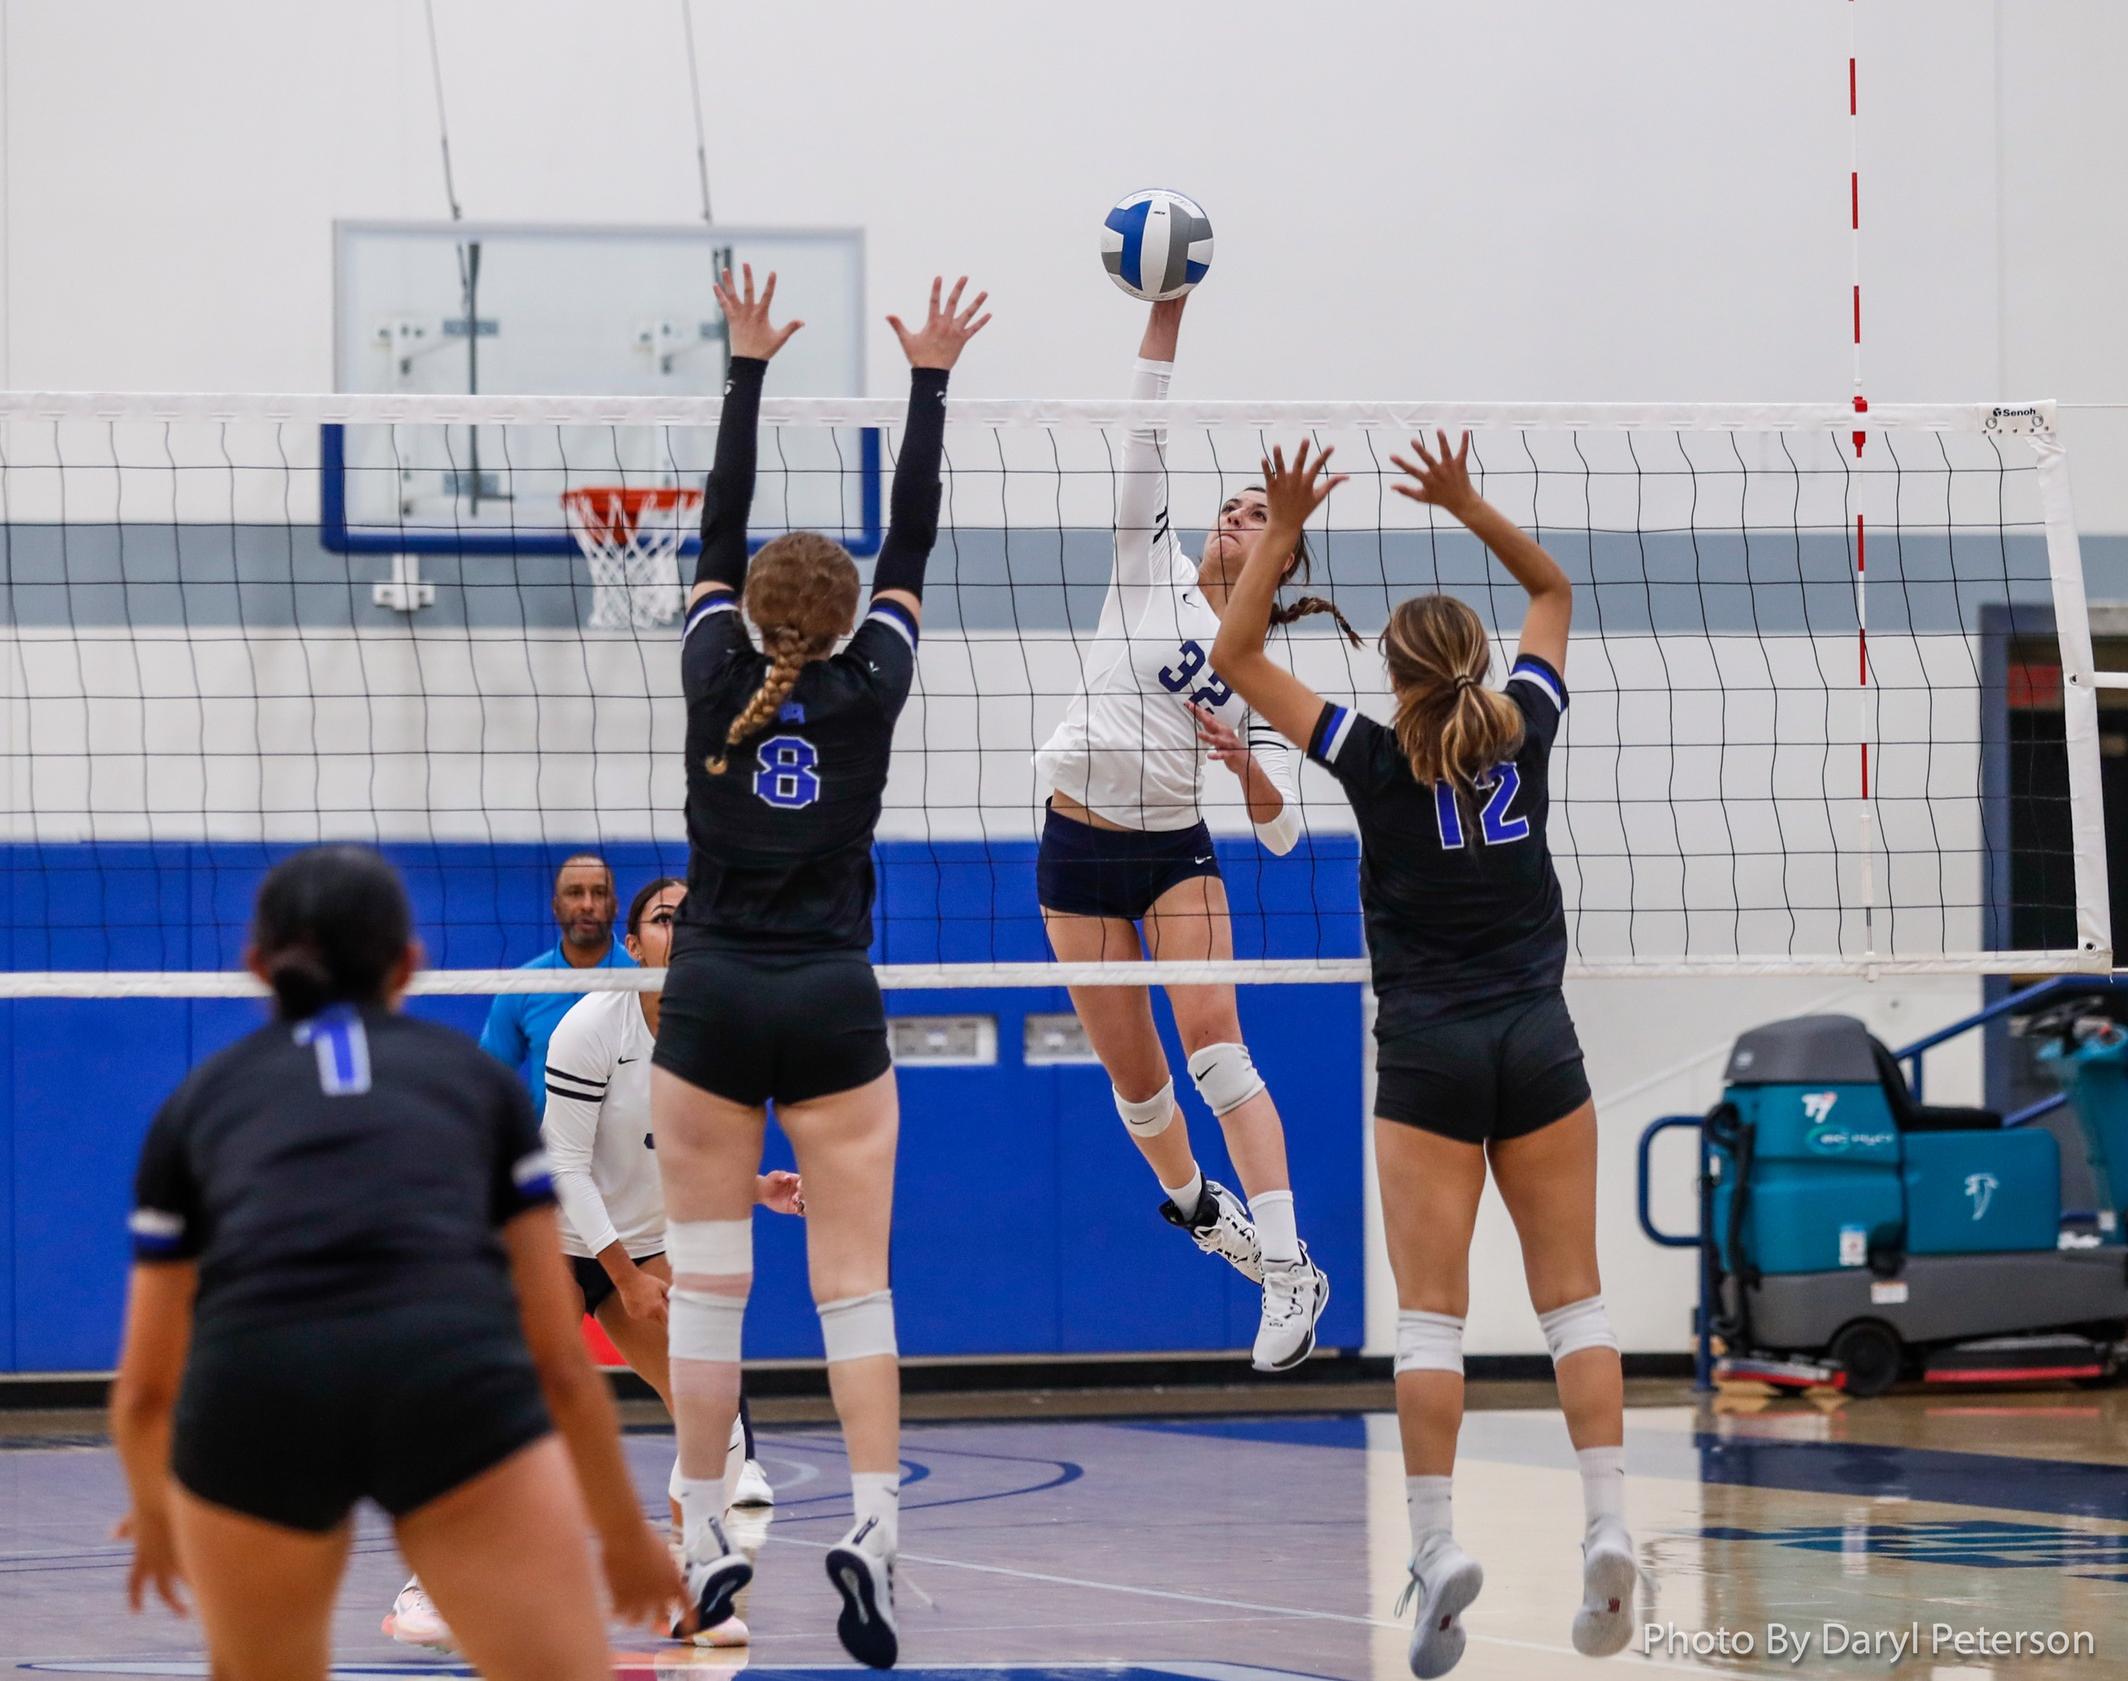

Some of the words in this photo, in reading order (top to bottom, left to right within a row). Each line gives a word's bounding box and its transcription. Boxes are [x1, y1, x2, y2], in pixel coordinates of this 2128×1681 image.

[2003, 407, 2036, 417] Senoh
[1158, 640, 1233, 715] 32
[752, 735, 820, 809] 8
[1434, 761, 1530, 850] 12
[292, 1001, 372, 1097] 1
